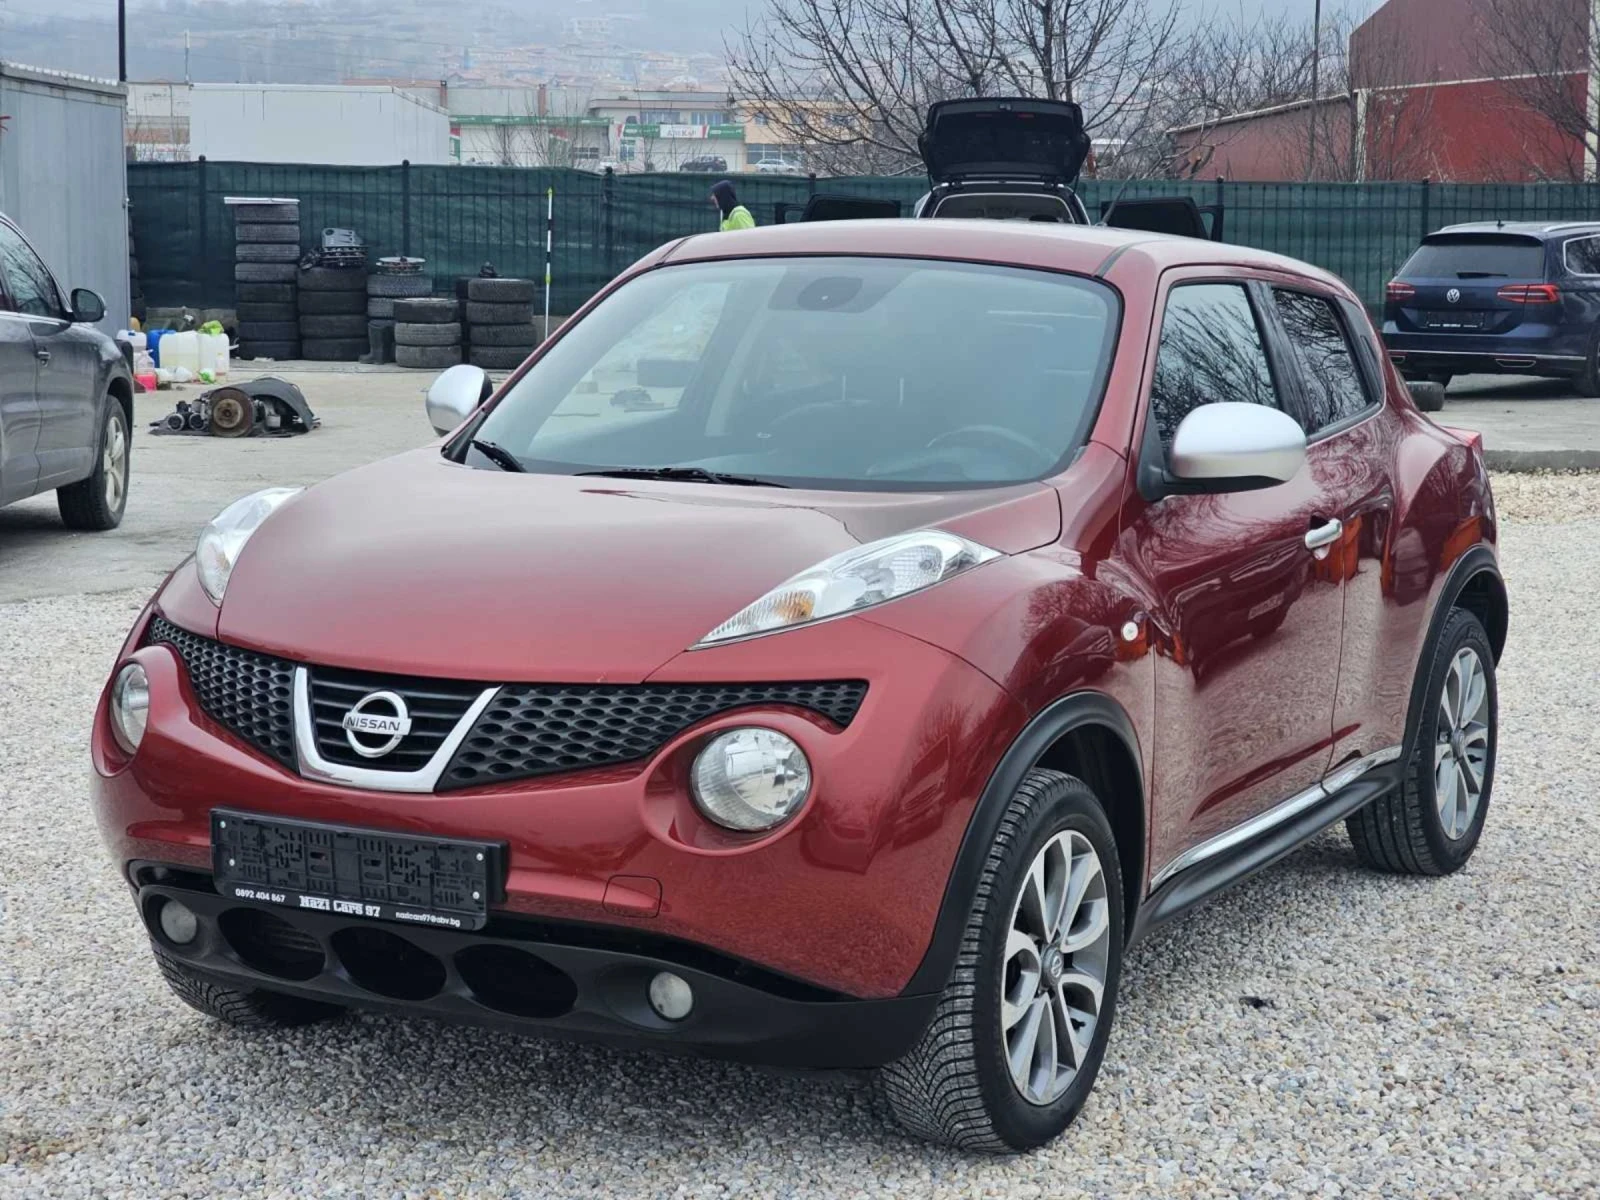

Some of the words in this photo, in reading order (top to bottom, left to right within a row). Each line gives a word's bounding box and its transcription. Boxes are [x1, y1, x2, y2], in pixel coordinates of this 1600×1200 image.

[346, 716, 401, 731] NISSAN
[235, 888, 254, 898] 0892
[255, 891, 270, 901] 404
[333, 900, 363, 916] Cars
